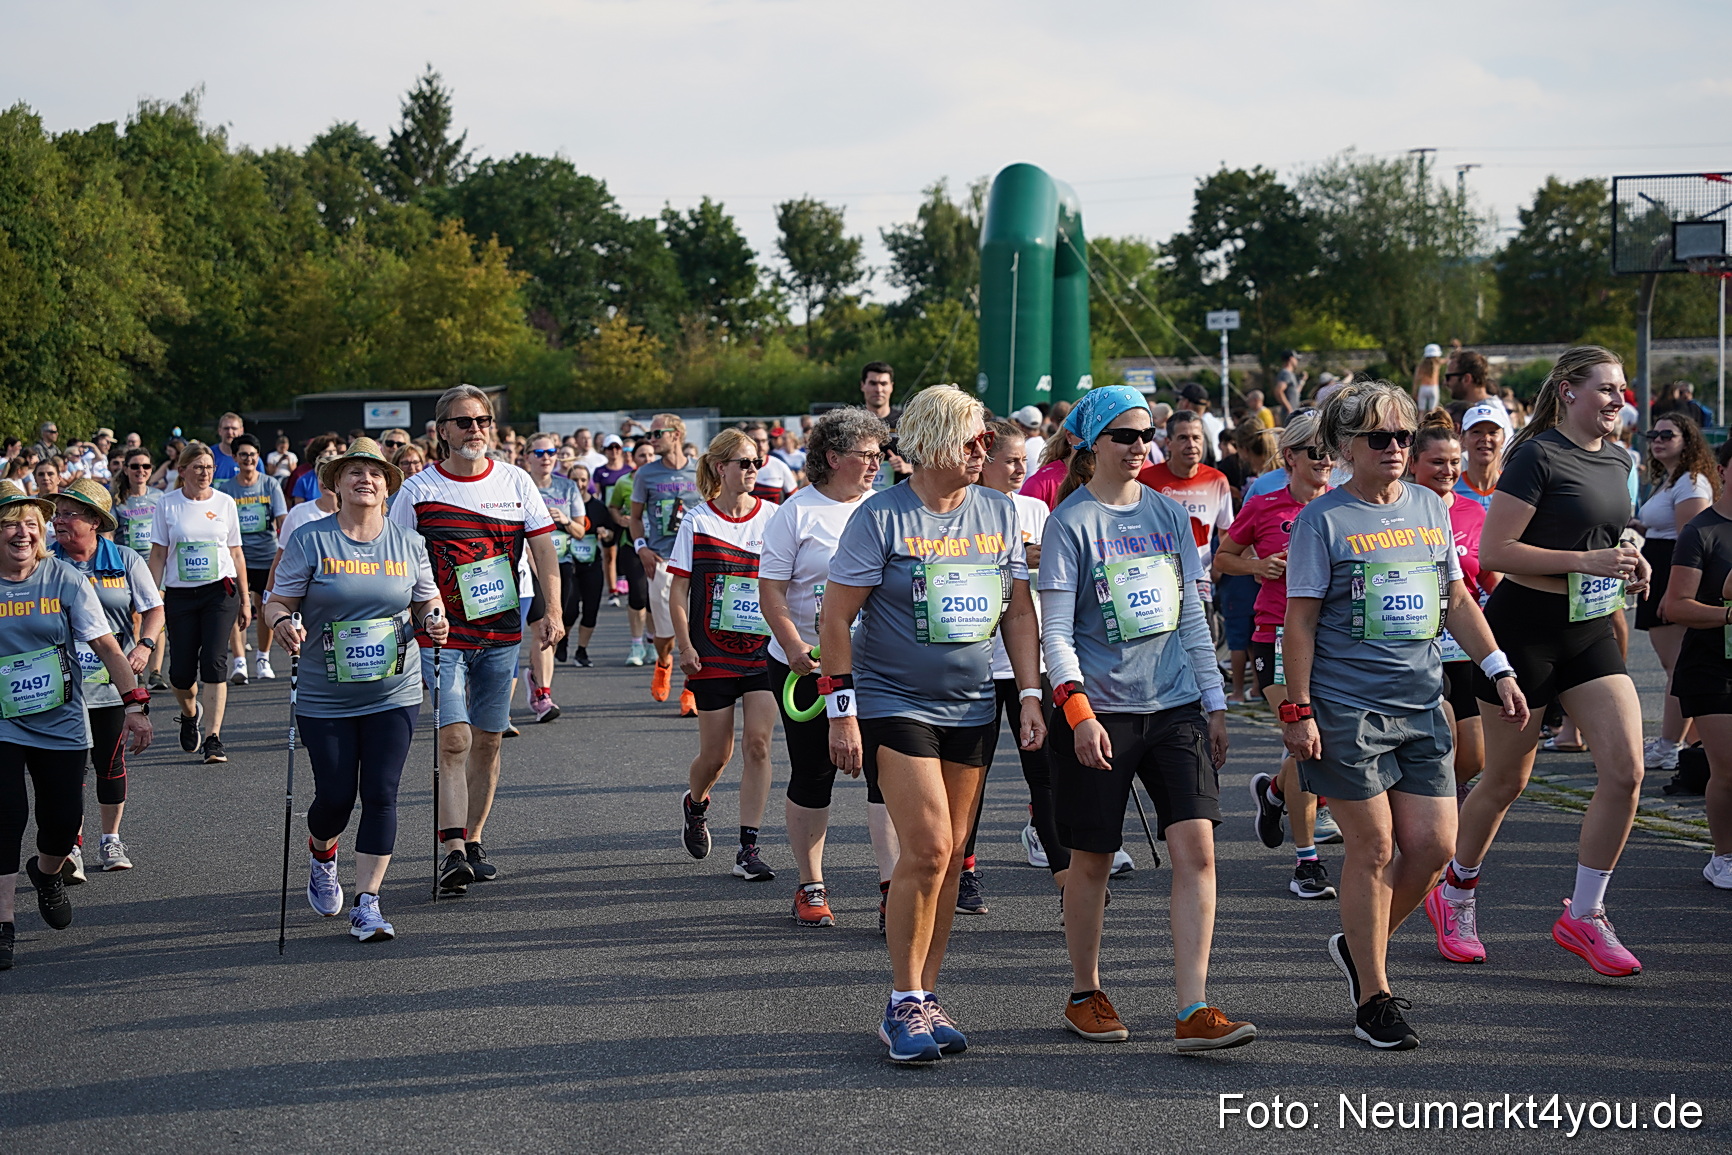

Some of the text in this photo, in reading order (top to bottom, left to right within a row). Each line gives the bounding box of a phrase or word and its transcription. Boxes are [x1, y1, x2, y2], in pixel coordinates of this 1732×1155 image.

[1036, 375, 1052, 391] AO
[1076, 375, 1093, 390] AO
[234, 496, 257, 505] iroler
[1182, 500, 1206, 512] fen
[904, 532, 1006, 557] Tiroler Hof
[1093, 532, 1174, 559] Tiroler Hof
[1346, 528, 1416, 555] Tiroler
[1417, 526, 1446, 546] Hof
[184, 557, 209, 566] 1403
[323, 557, 408, 577] Tiroler Hof
[471, 580, 505, 598] 2640
[1581, 577, 1617, 595] 2382
[942, 596, 988, 613] 2500
[1127, 588, 1161, 608] 250
[1383, 595, 1423, 611] 2510
[0, 597, 61, 617] oler Ho
[733, 600, 761, 614] 262
[1135, 610, 1154, 618] Mona
[1406, 613, 1427, 622] Siegert
[77, 652, 101, 664] 493
[345, 644, 385, 659] 2509
[10, 674, 51, 694] 2497
[13, 688, 55, 702] Bettina Bogner
